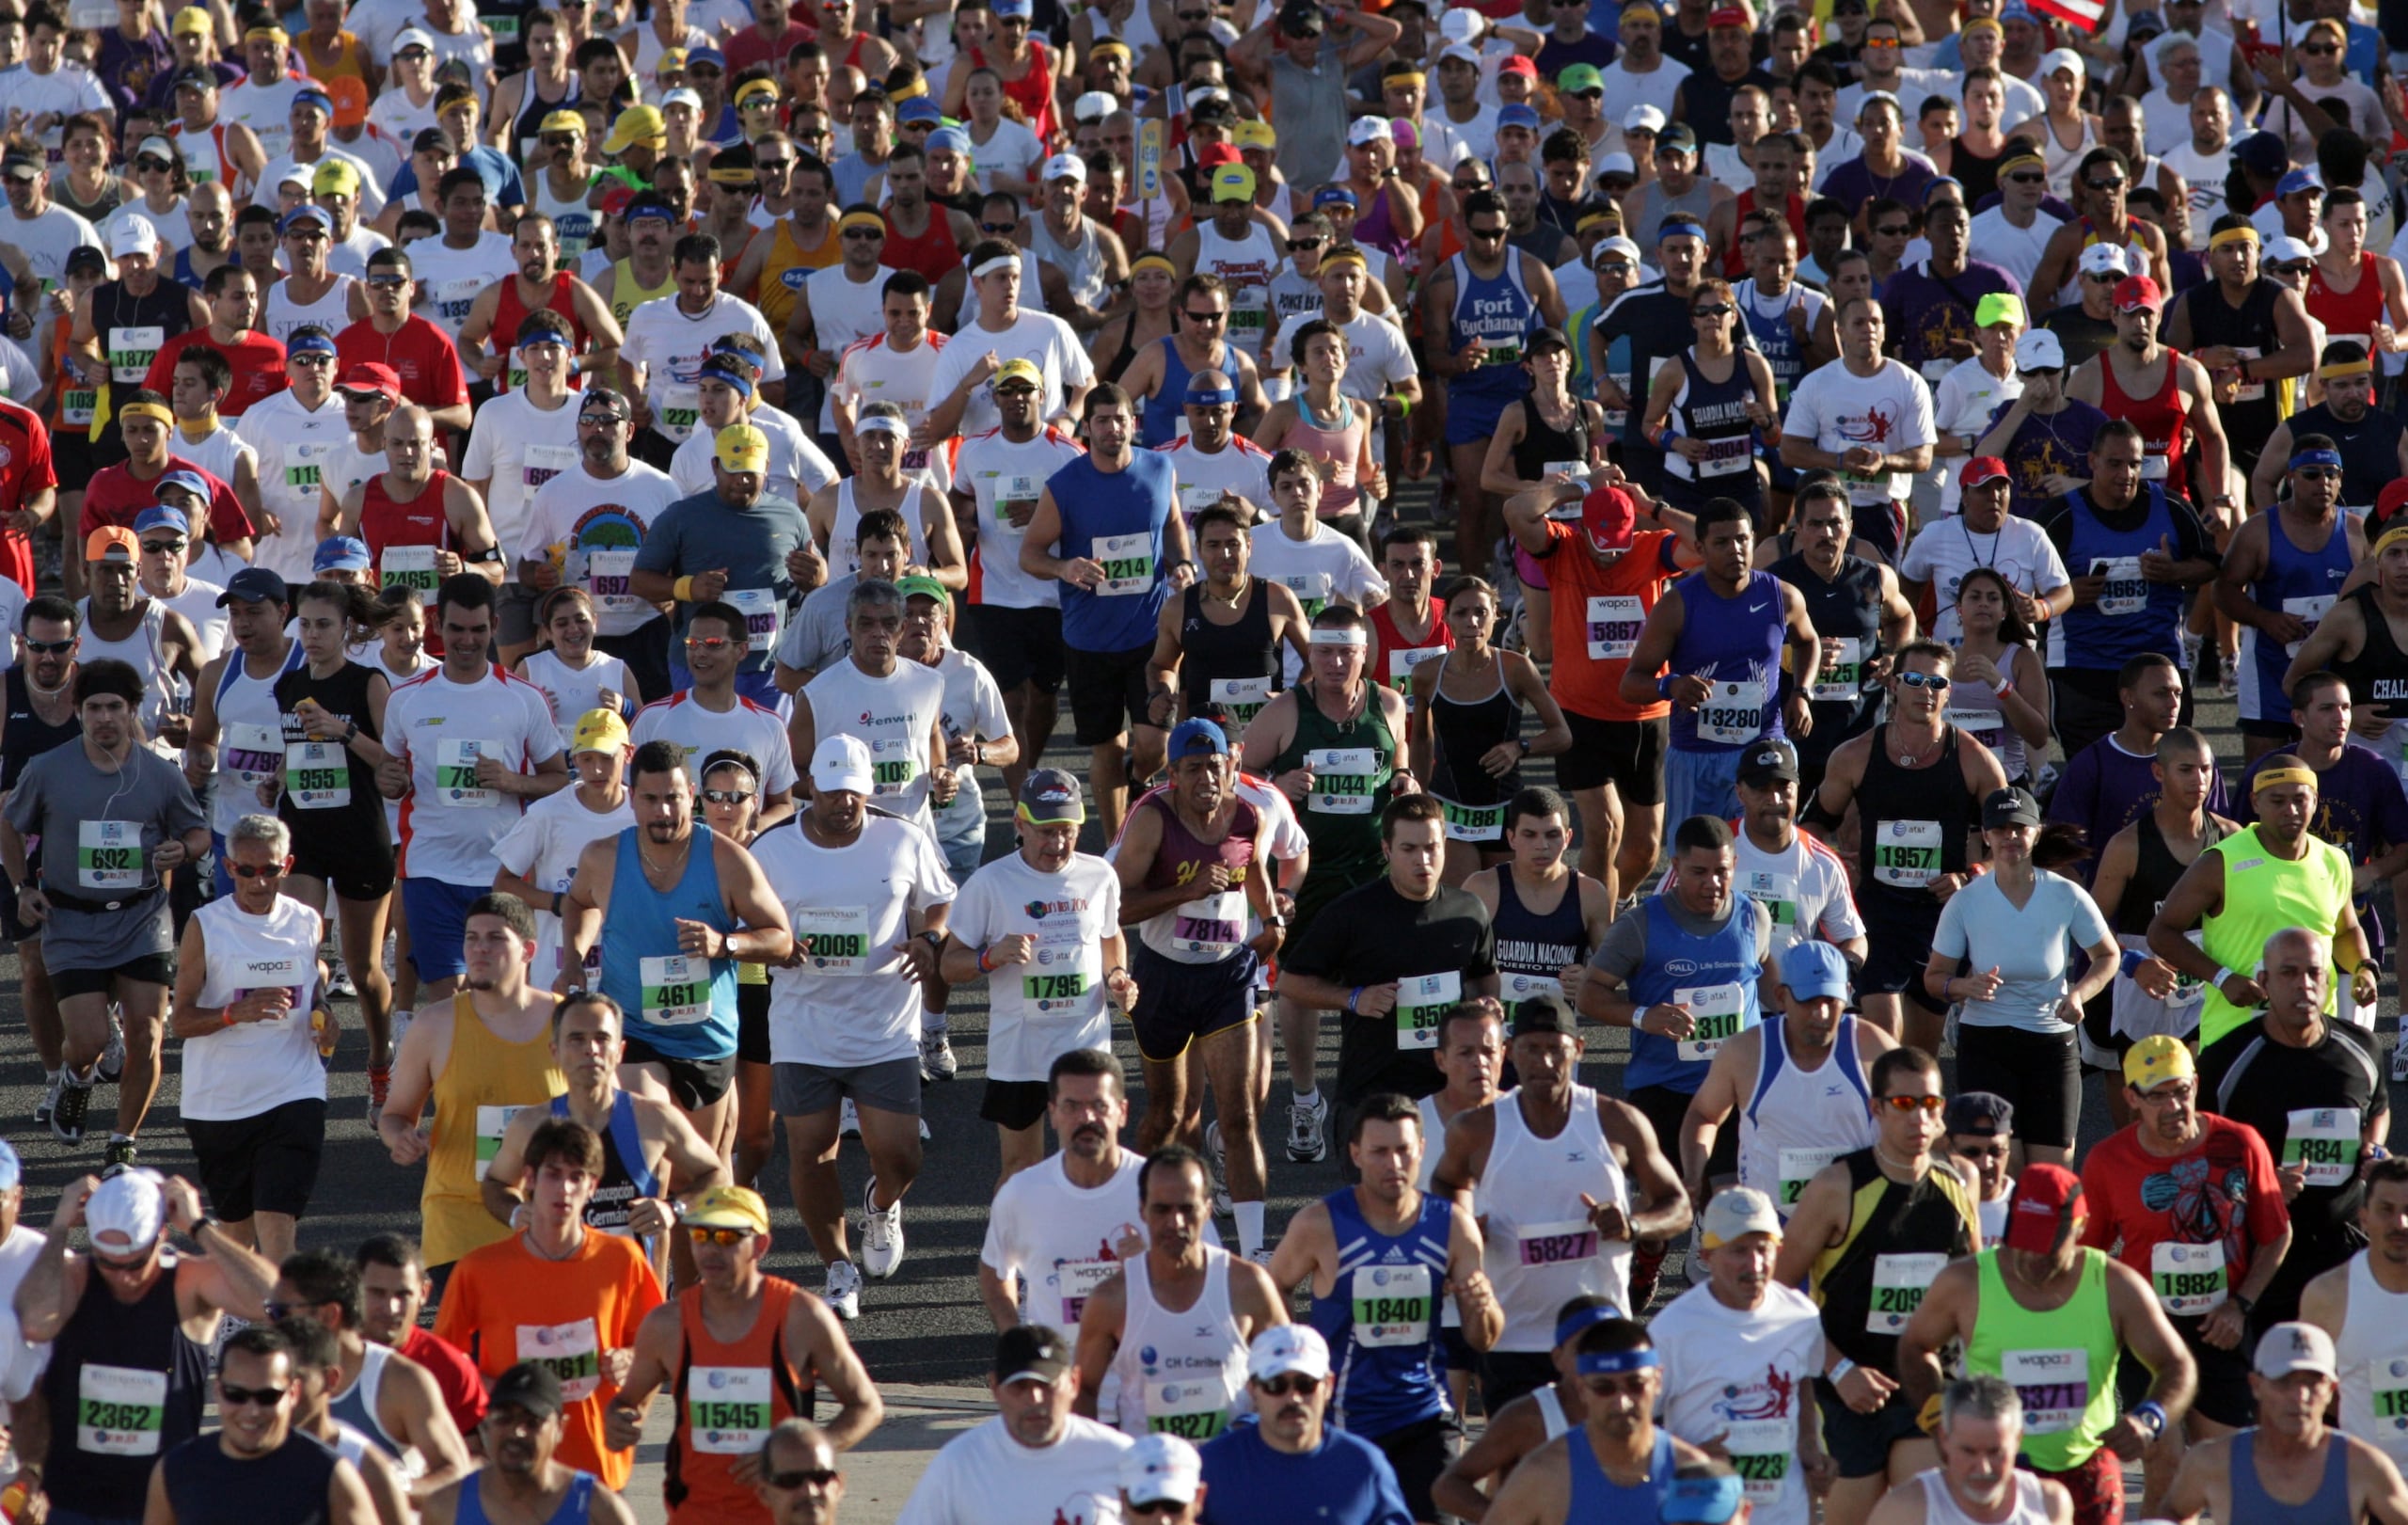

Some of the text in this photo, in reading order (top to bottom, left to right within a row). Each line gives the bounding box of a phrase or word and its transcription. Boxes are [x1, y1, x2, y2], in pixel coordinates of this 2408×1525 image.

[2367, 196, 2392, 223] TAFF
[1475, 300, 1514, 316] Fort
[1462, 319, 1525, 340] Buchanan
[69, 390, 99, 408] 103
[668, 408, 697, 426] 221
[1692, 402, 1751, 425] GUARDIA NACIO
[1122, 538, 1136, 548] at&t
[1104, 558, 1149, 580] 1214
[385, 571, 432, 591] 2465
[1593, 621, 1641, 643] 5867
[1242, 685, 1258, 693] at&t
[2373, 678, 2408, 700] CHAL
[867, 712, 917, 726] Fenwal
[1700, 707, 1761, 730] 13280
[888, 739, 906, 749] at&t
[1342, 754, 1359, 763] at&t
[299, 768, 336, 790] 955
[451, 766, 481, 788] 78
[880, 761, 910, 782] 103
[1317, 774, 1366, 796] 1044
[1449, 805, 1497, 828] 1188
[1909, 827, 1926, 836] at&t
[1882, 847, 1934, 869] 1957
[1186, 917, 1233, 942] 7814
[808, 933, 858, 958] 2009
[1052, 951, 1069, 961] at&t
[1497, 939, 1577, 965] GUARDIA NACIONAL
[663, 974, 691, 983] Manuel
[1668, 962, 1693, 975] PALL
[1700, 961, 1714, 973] Life
[657, 986, 696, 1007] 461
[1029, 976, 1079, 999] 1795
[1530, 983, 1548, 993] at&t
[1708, 993, 1728, 1002] at&t
[2299, 1138, 2341, 1163] 884
[1528, 1233, 1589, 1264] 5827
[2191, 1250, 2210, 1260] at&t
[1391, 1272, 1414, 1281] at&t
[2162, 1271, 2220, 1297] 1982
[1362, 1297, 1421, 1325] 1840
[1880, 1288, 1923, 1313] 209
[1164, 1356, 1222, 1369] CH Caribe
[728, 1376, 749, 1386] at&t
[87, 1401, 151, 1431] 2362
[697, 1402, 760, 1429] 1545
[1154, 1412, 1216, 1439] 1827
